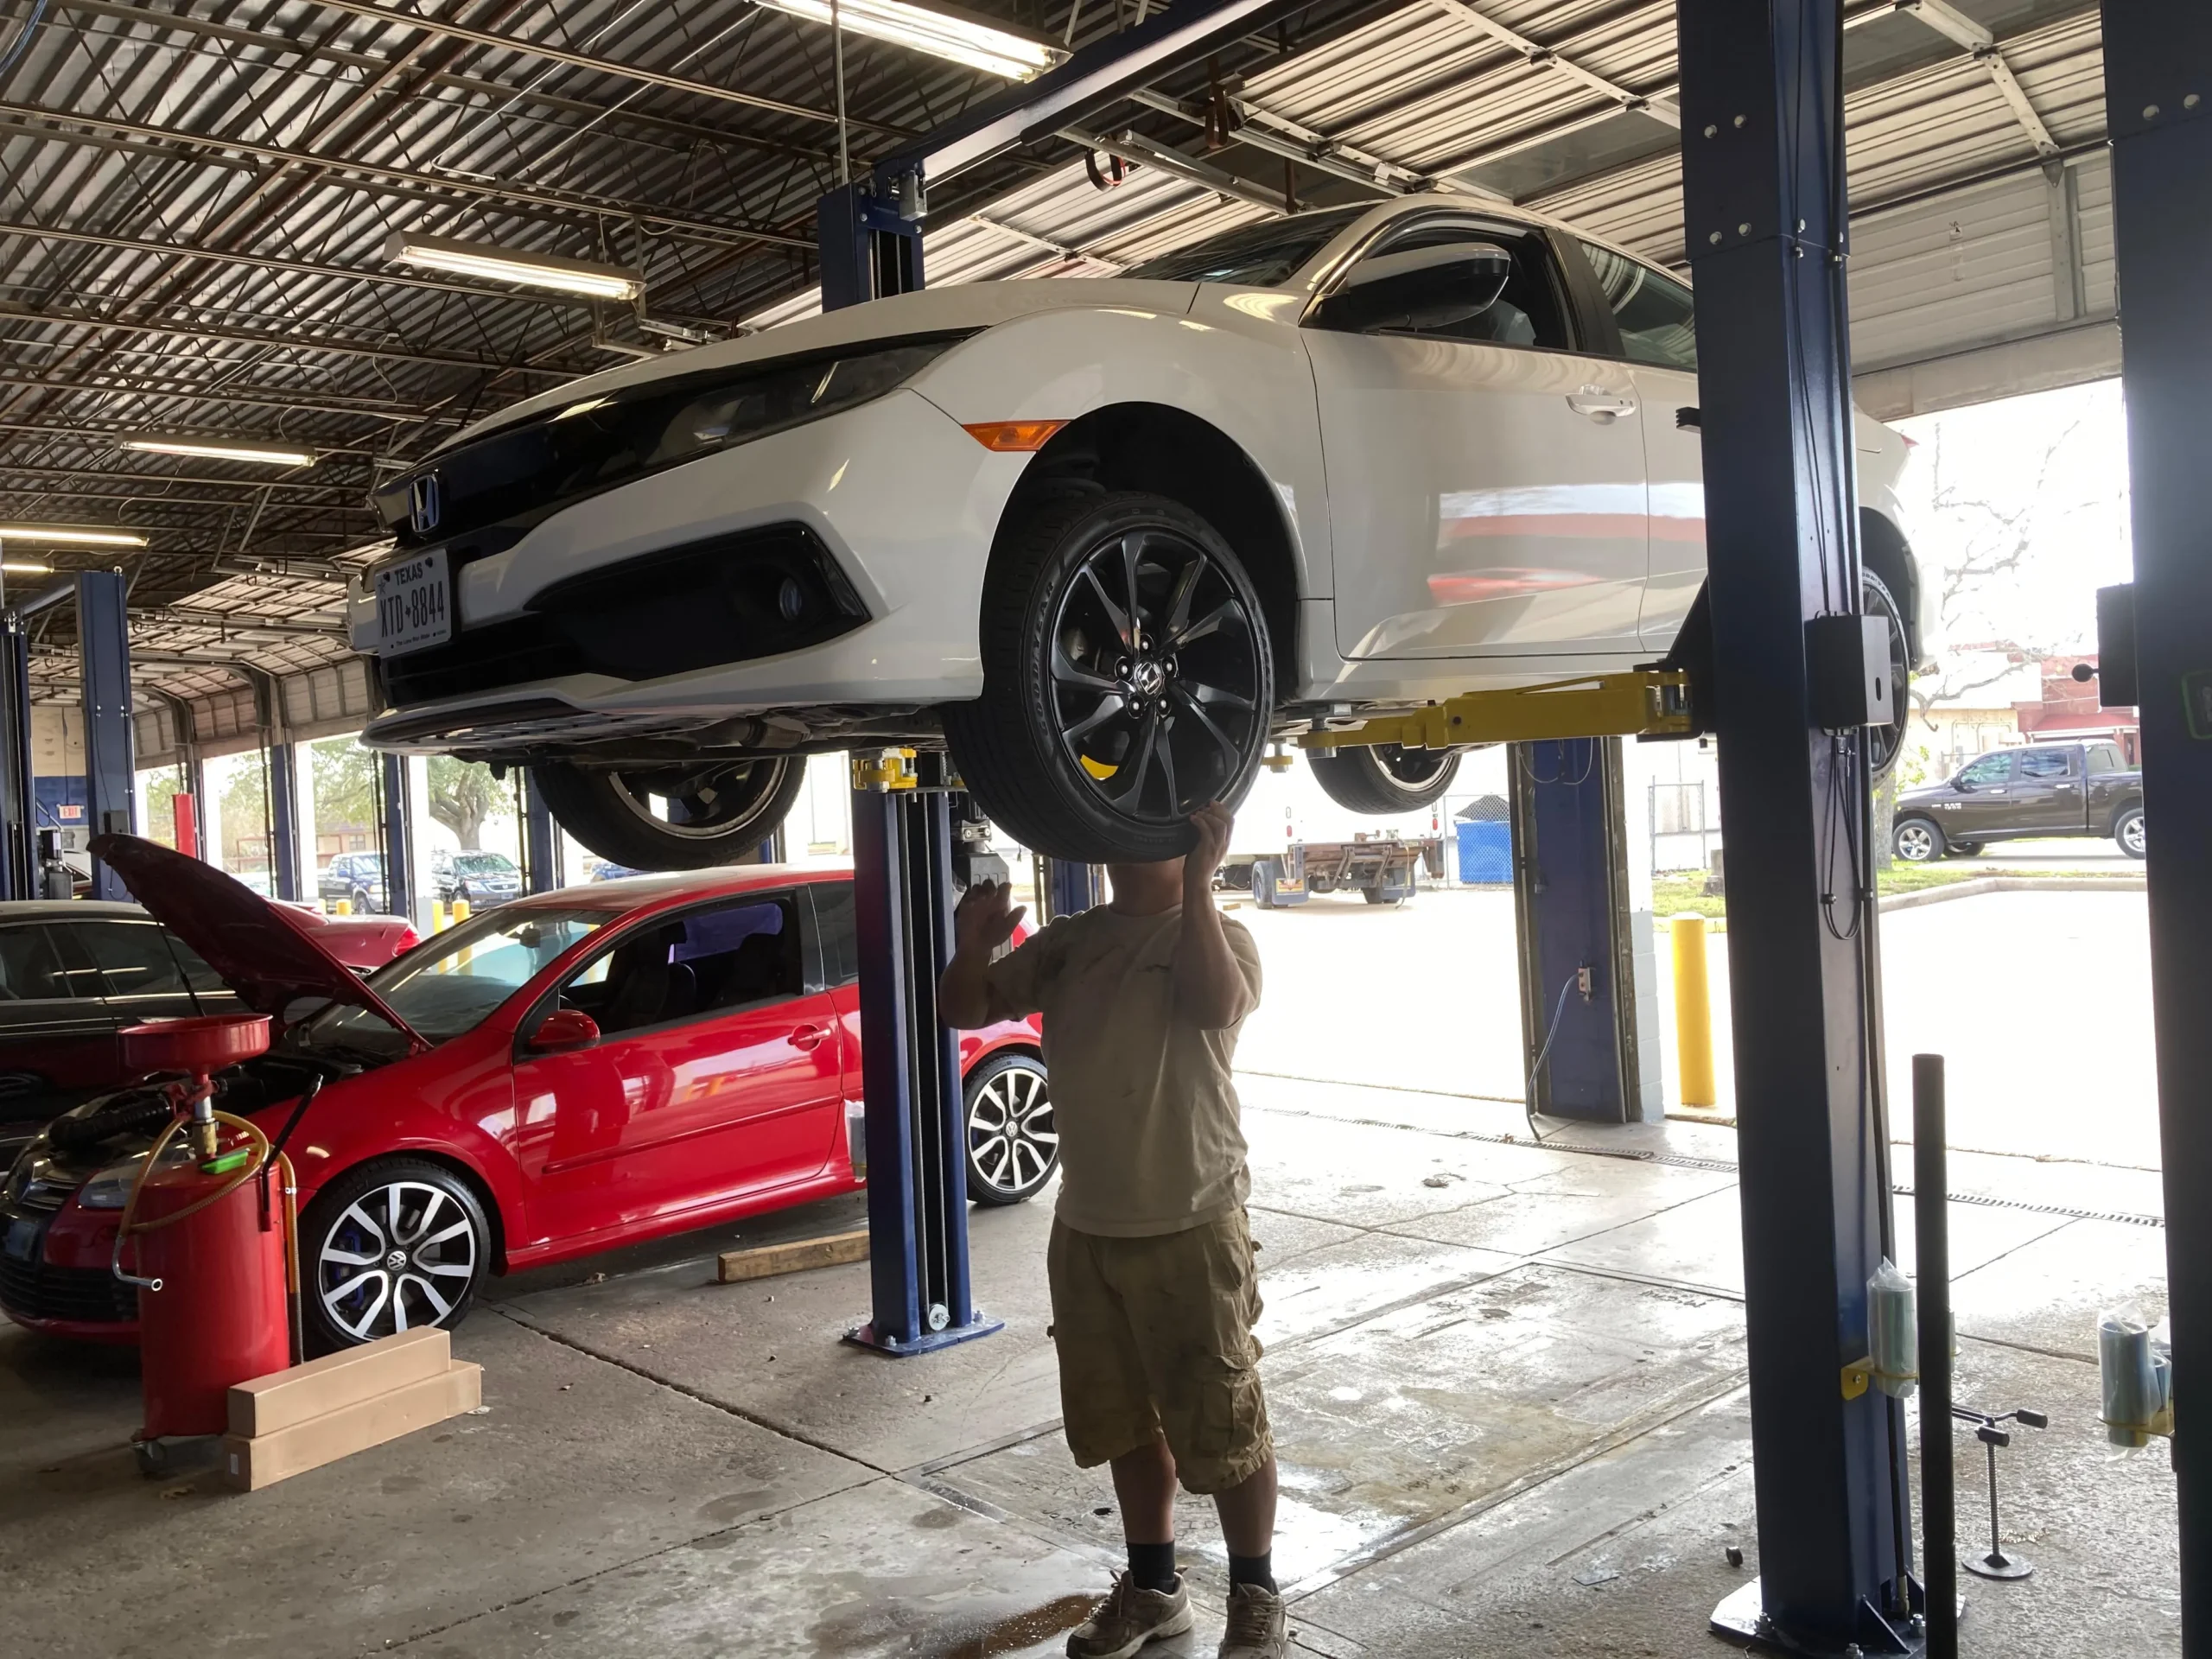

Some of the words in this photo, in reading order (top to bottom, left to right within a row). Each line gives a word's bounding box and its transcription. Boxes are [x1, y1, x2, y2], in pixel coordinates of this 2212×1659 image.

[394, 563, 423, 586] TEXAS
[380, 594, 404, 638] XTD
[411, 581, 444, 628] 8844
[1030, 582, 1053, 735] GOODYEAR
[63, 807, 79, 817] EXIT
